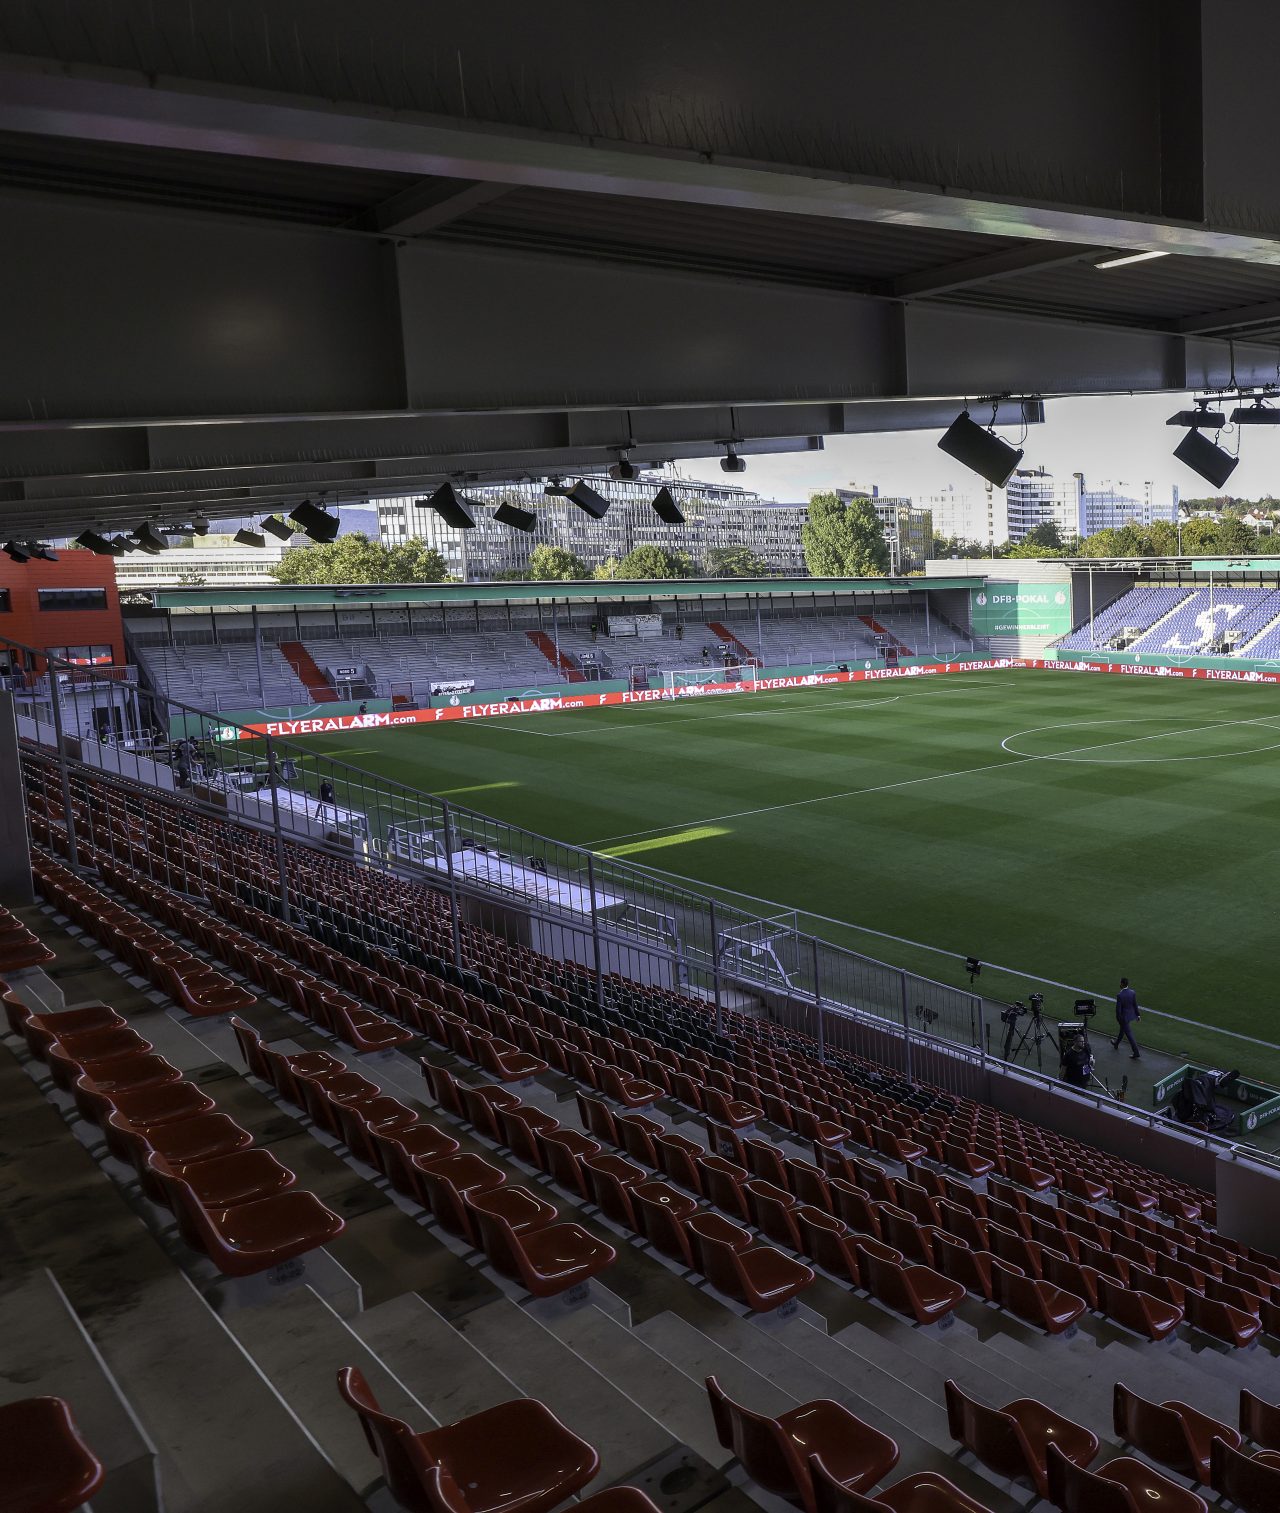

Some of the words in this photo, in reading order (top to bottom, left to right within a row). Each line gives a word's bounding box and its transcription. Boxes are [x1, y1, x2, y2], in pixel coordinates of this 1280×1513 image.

[992, 595, 1049, 604] DFB-POKAL
[1044, 660, 1101, 671] FLYERALARM.com
[1121, 665, 1183, 677] FLYERALARM.com
[1206, 669, 1277, 682] FLYERALARM.com
[266, 713, 417, 735] FLYERALARM.com
[463, 698, 584, 718] FLYERALARM.com
[755, 674, 838, 691] FLYERALARM.com
[865, 666, 937, 680] FLYERALARM.com
[959, 659, 1027, 671] FLYERALARM.com
